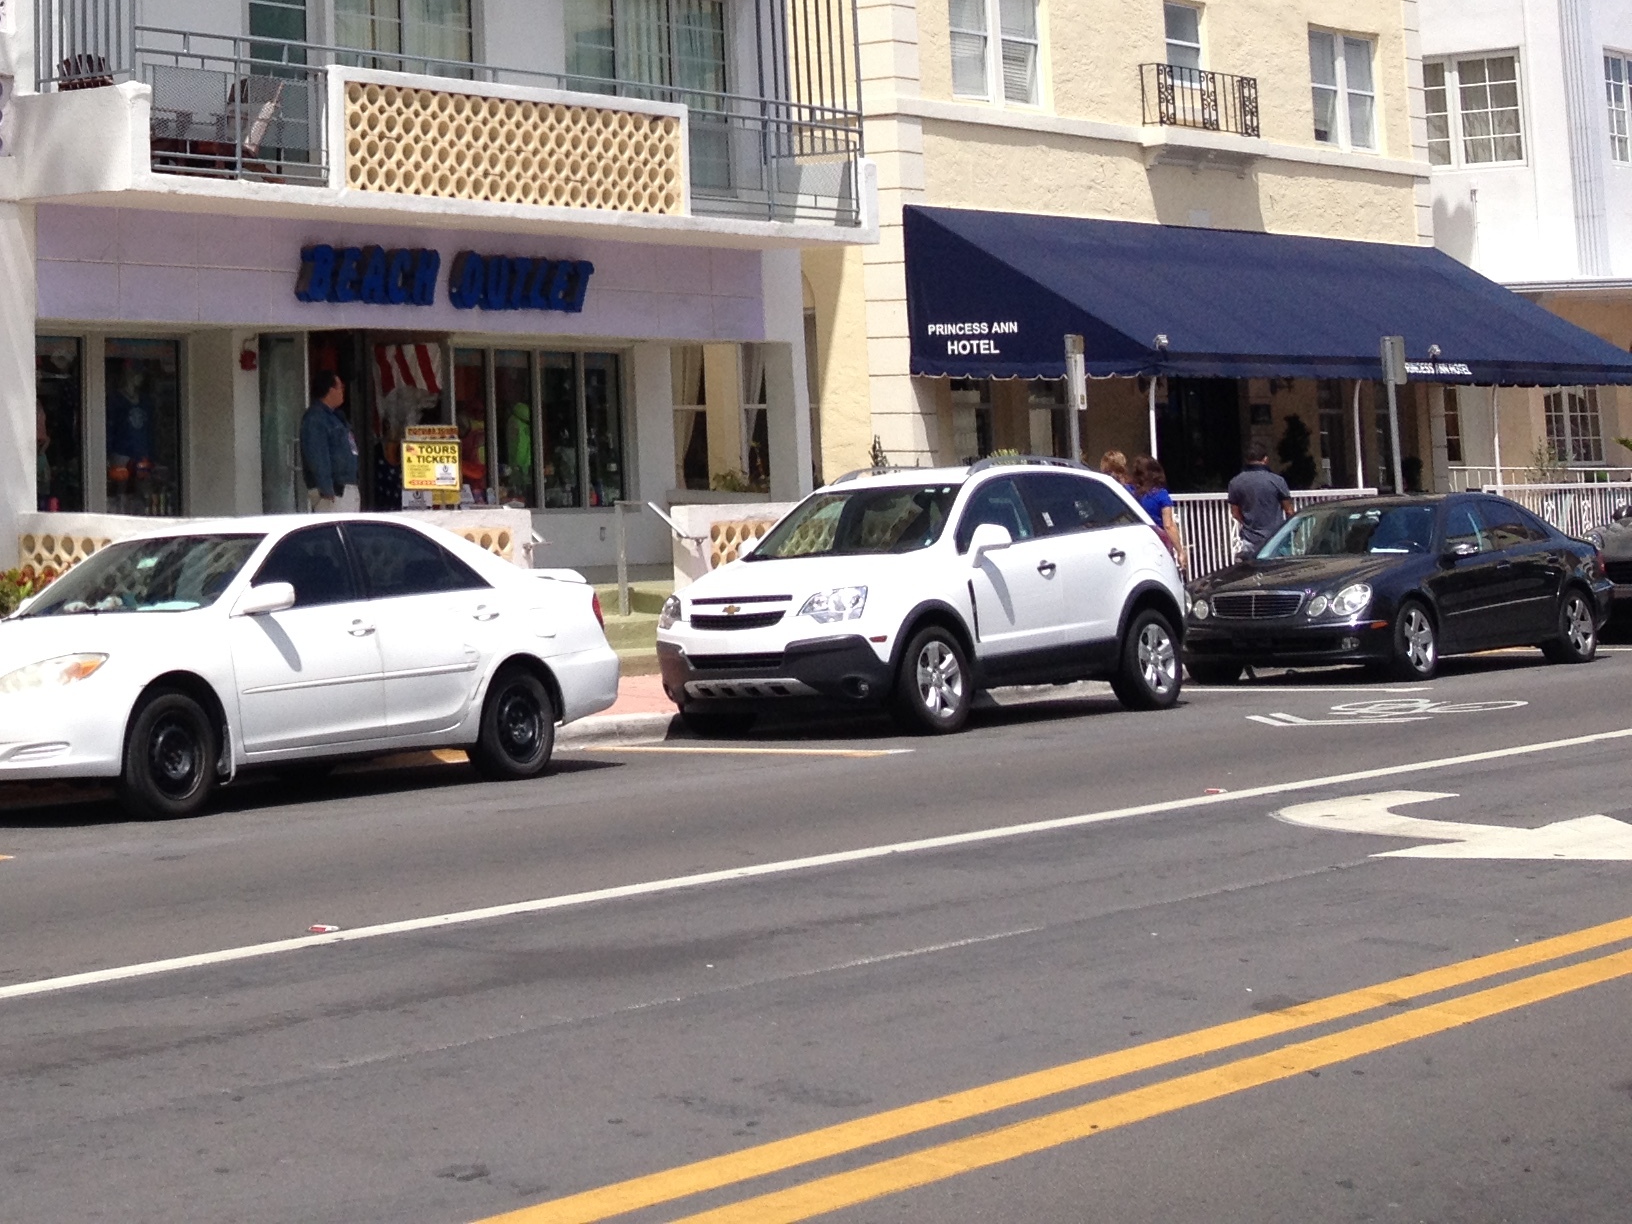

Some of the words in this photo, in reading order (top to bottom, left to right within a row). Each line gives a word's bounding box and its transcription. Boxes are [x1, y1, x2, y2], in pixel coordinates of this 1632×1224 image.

[294, 244, 441, 306] BEACH
[448, 250, 595, 313] OUTLET
[927, 322, 989, 336] PRINCESS
[991, 321, 1019, 334] ANN
[947, 340, 1000, 355] HOTEL
[418, 445, 457, 455] TOURS
[416, 455, 458, 464] TICKETS
